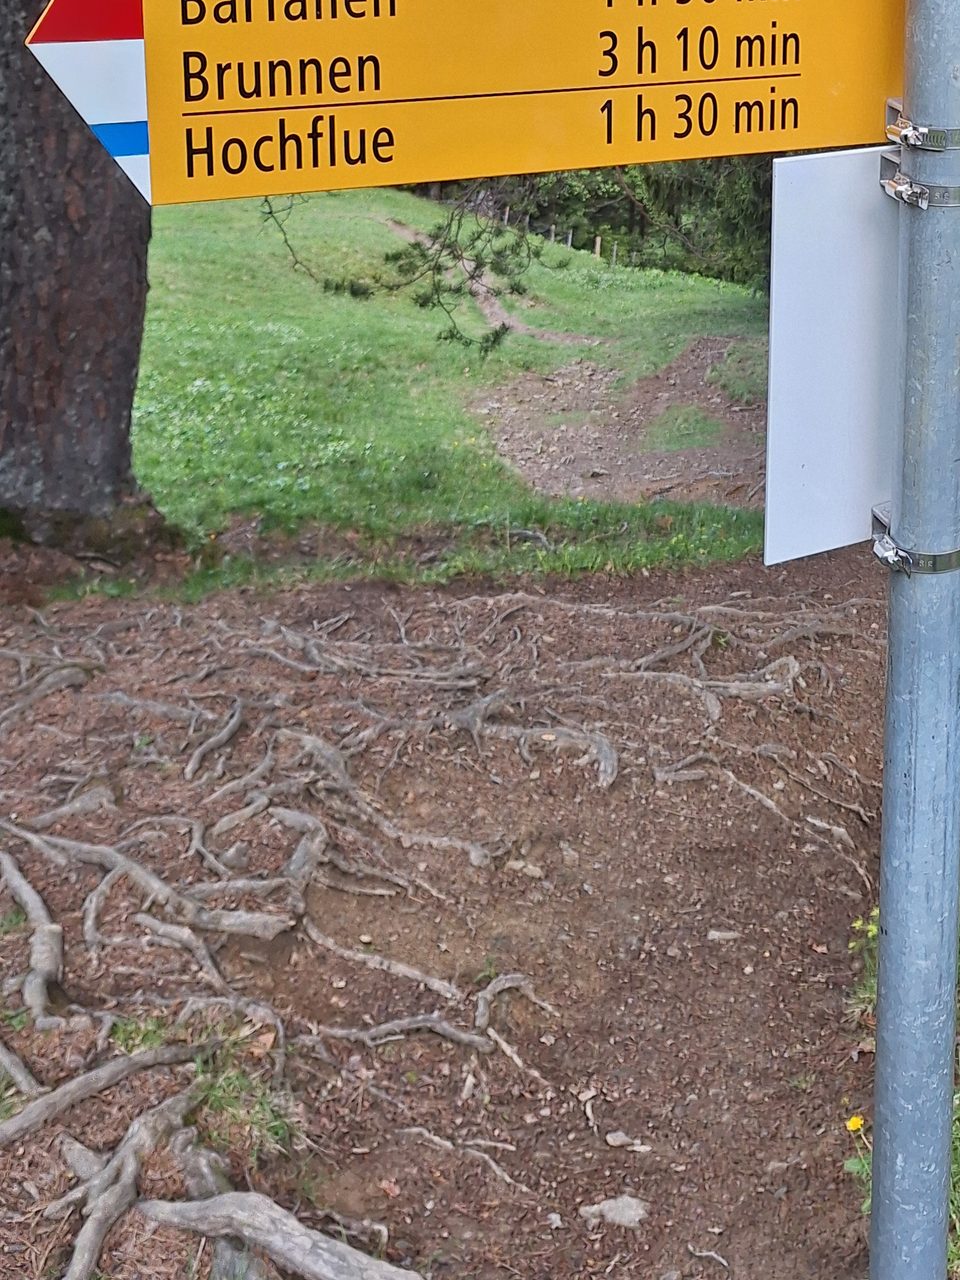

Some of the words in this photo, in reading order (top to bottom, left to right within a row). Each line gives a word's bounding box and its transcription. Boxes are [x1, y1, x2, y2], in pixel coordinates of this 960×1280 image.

[182, 50, 382, 102] Brunnen
[598, 30, 619, 77] 3
[637, 25, 657, 75] h
[676, 25, 719, 72] 10
[735, 20, 800, 69] min
[184, 115, 395, 178] Hochflue
[600, 99, 613, 145] 1
[636, 93, 656, 142] h
[673, 92, 718, 139] 30
[734, 86, 799, 134] min
